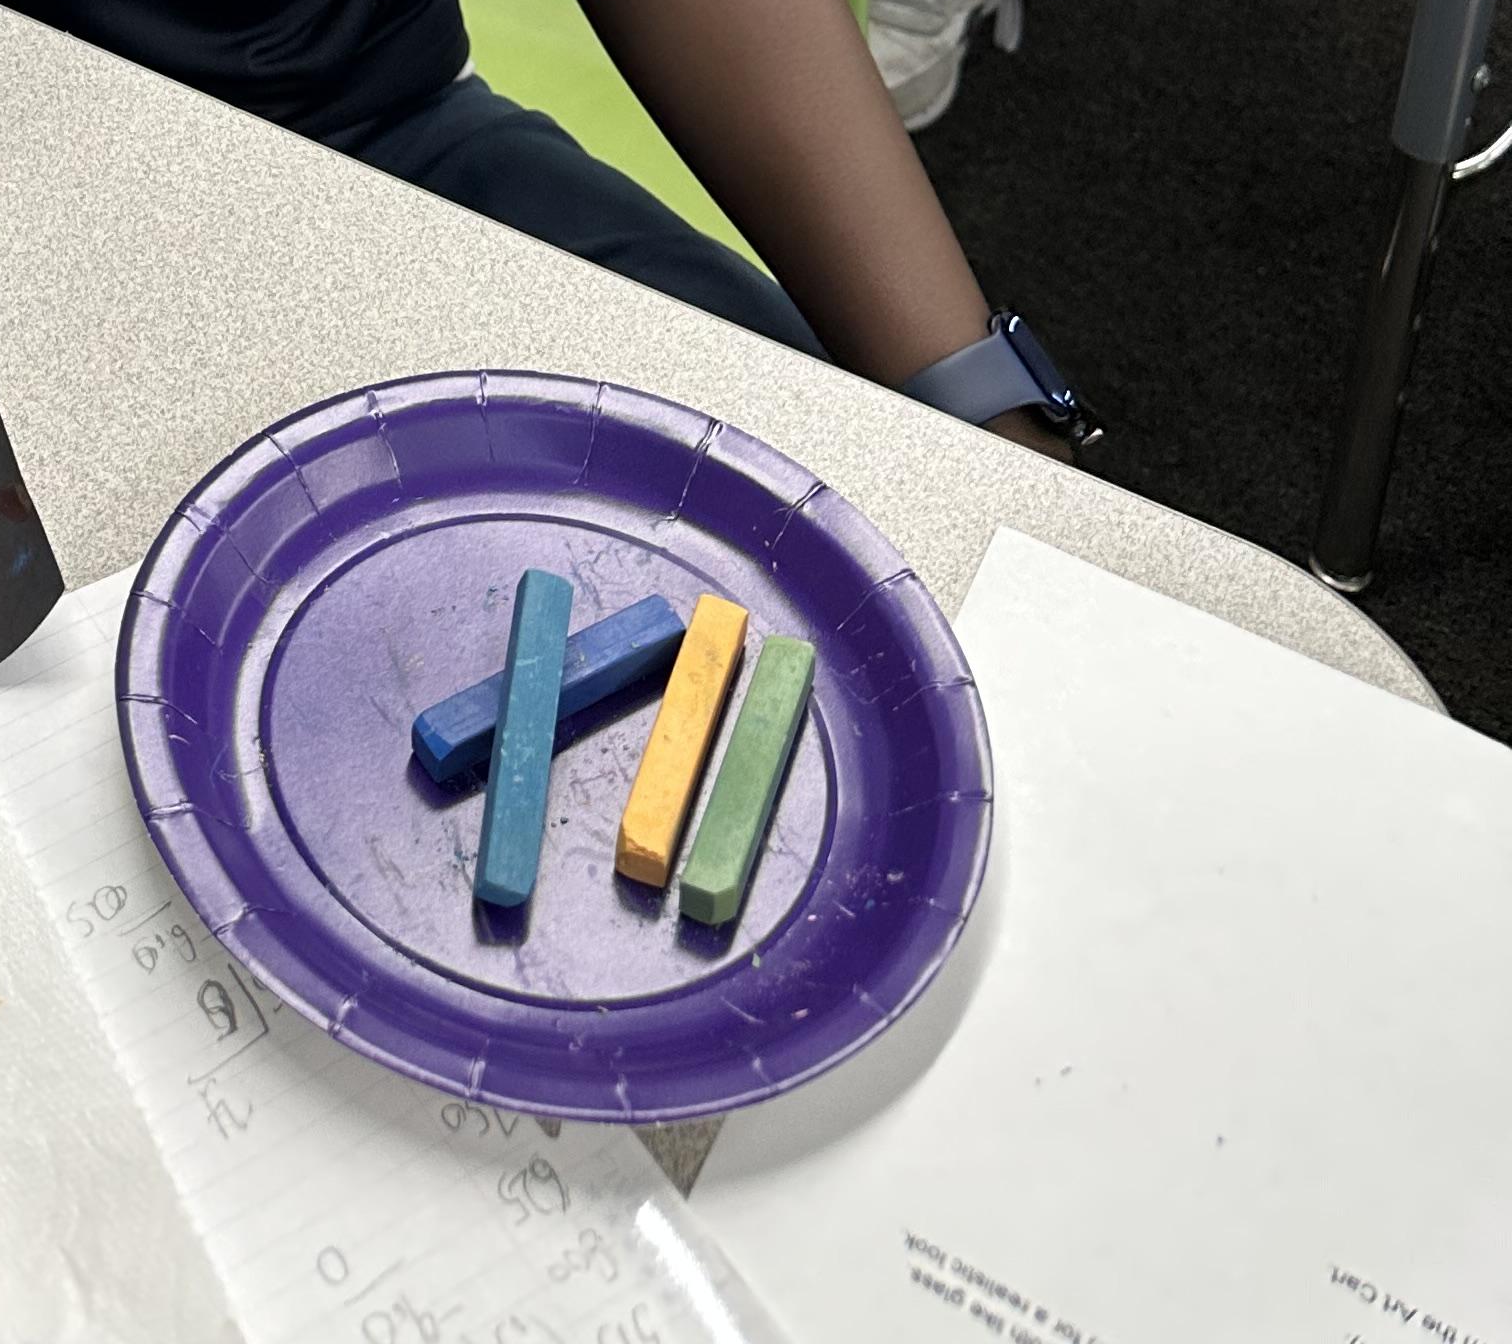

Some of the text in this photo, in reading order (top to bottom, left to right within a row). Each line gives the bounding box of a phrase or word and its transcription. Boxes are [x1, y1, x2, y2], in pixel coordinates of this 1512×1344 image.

[950, 1256, 1031, 1314] realistic
[969, 1299, 1006, 1336] like
[1382, 1292, 1419, 1323] Art
[1421, 1312, 1458, 1344] the
